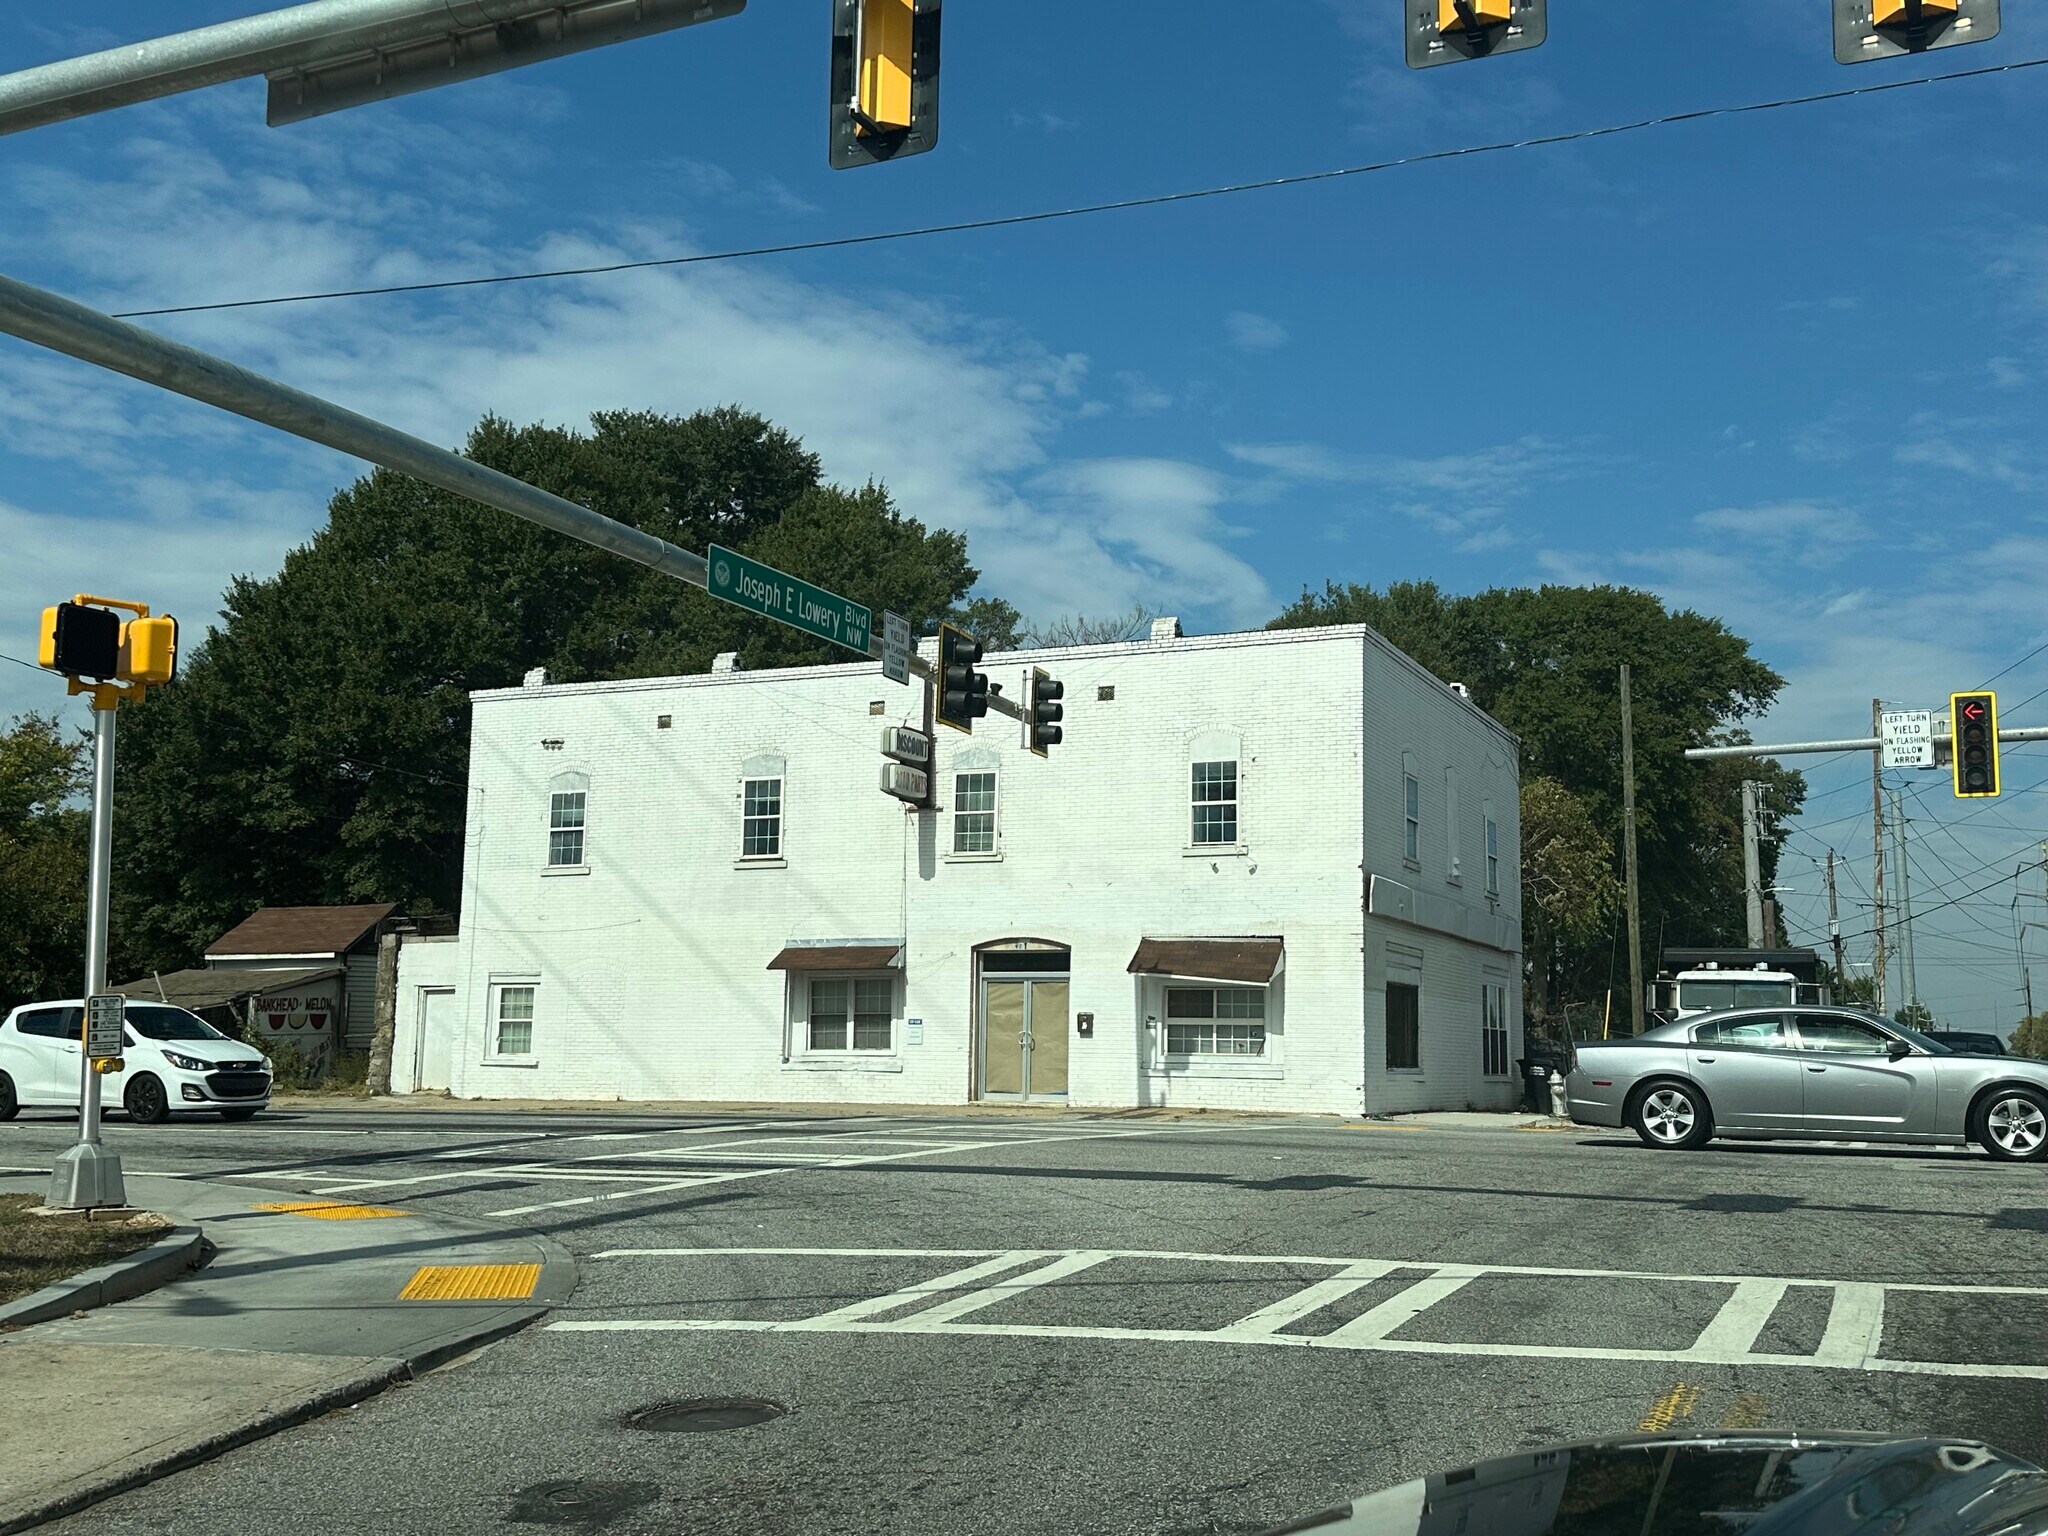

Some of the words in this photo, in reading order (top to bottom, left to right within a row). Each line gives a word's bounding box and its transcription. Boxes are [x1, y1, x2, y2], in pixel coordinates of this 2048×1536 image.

[735, 567, 781, 612] Joseph
[786, 586, 794, 614] E
[799, 591, 840, 638] Lowery
[845, 605, 867, 629] Blvd
[846, 626, 862, 647] NW
[1885, 716, 1903, 724] LEFT
[1907, 714, 1927, 722] TURN
[1893, 725, 1921, 735] YIELD
[1896, 736, 1931, 745] FLASHING
[1892, 746, 1923, 755] YELLOW
[1894, 756, 1922, 764] ARROW
[256, 997, 299, 1013] BANKHEAD
